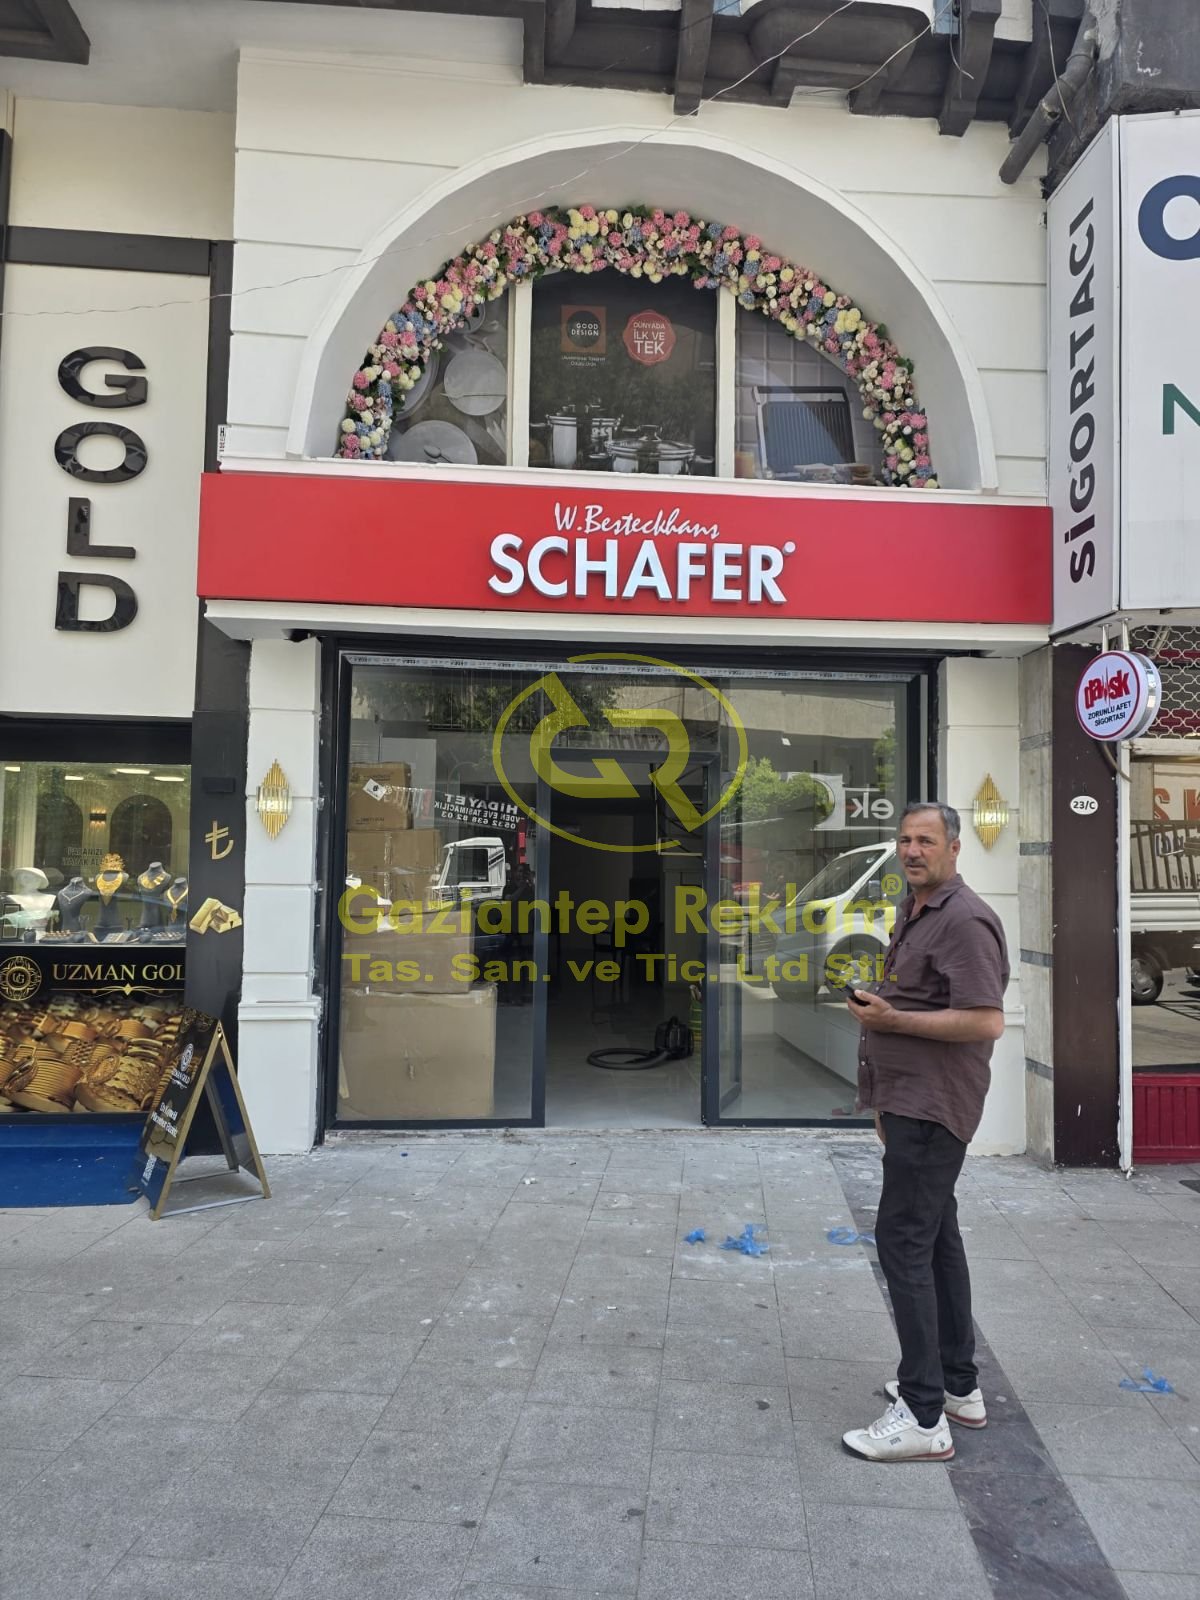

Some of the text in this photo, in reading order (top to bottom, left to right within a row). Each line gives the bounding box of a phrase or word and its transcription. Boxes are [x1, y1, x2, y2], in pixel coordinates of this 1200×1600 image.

[576, 322, 599, 330] GOOD
[633, 321, 666, 329] DÜNYADA
[651, 331, 665, 341] VE
[633, 340, 665, 355] TEK
[54, 345, 148, 633] GOLD
[488, 533, 788, 603] SCHAFER
[1087, 700, 1132, 720] ZORUNLU AFET
[1072, 800, 1096, 810] 23/C
[53, 963, 136, 981] UZMAN
